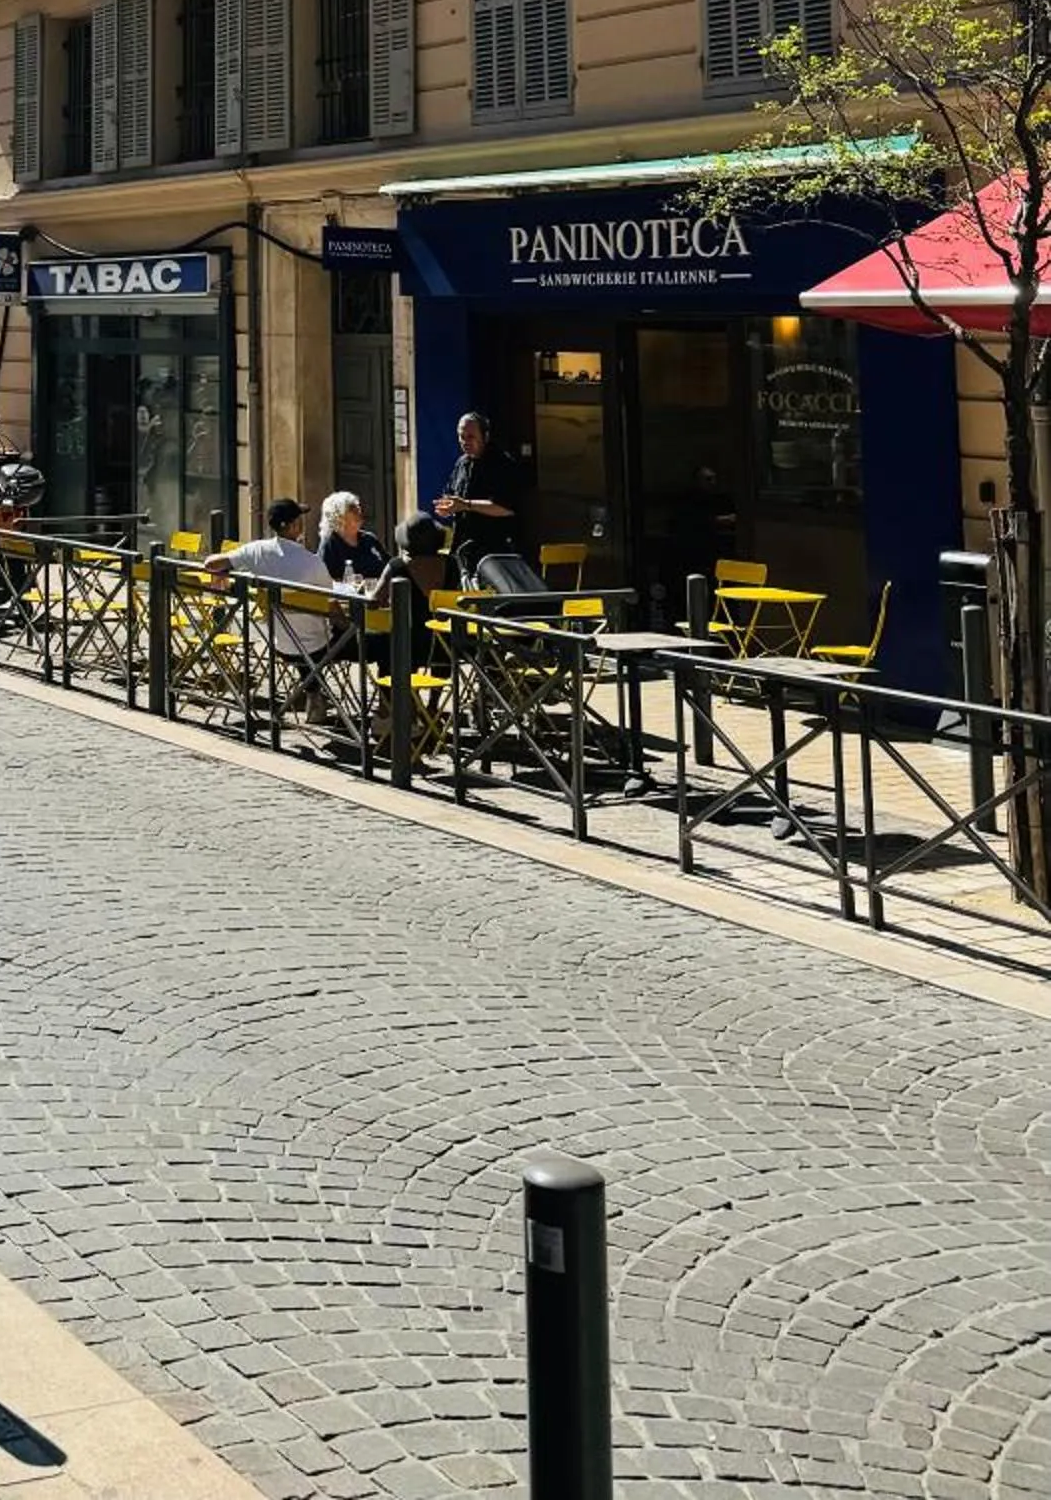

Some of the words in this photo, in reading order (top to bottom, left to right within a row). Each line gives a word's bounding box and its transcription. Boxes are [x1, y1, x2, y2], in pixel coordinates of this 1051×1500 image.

[508, 215, 751, 264] PANINOTECA
[49, 259, 182, 295] TABAC
[539, 272, 637, 287] SANDWICHERIE
[640, 269, 718, 286] ITALIENNE
[757, 390, 861, 413] FOCACCI
